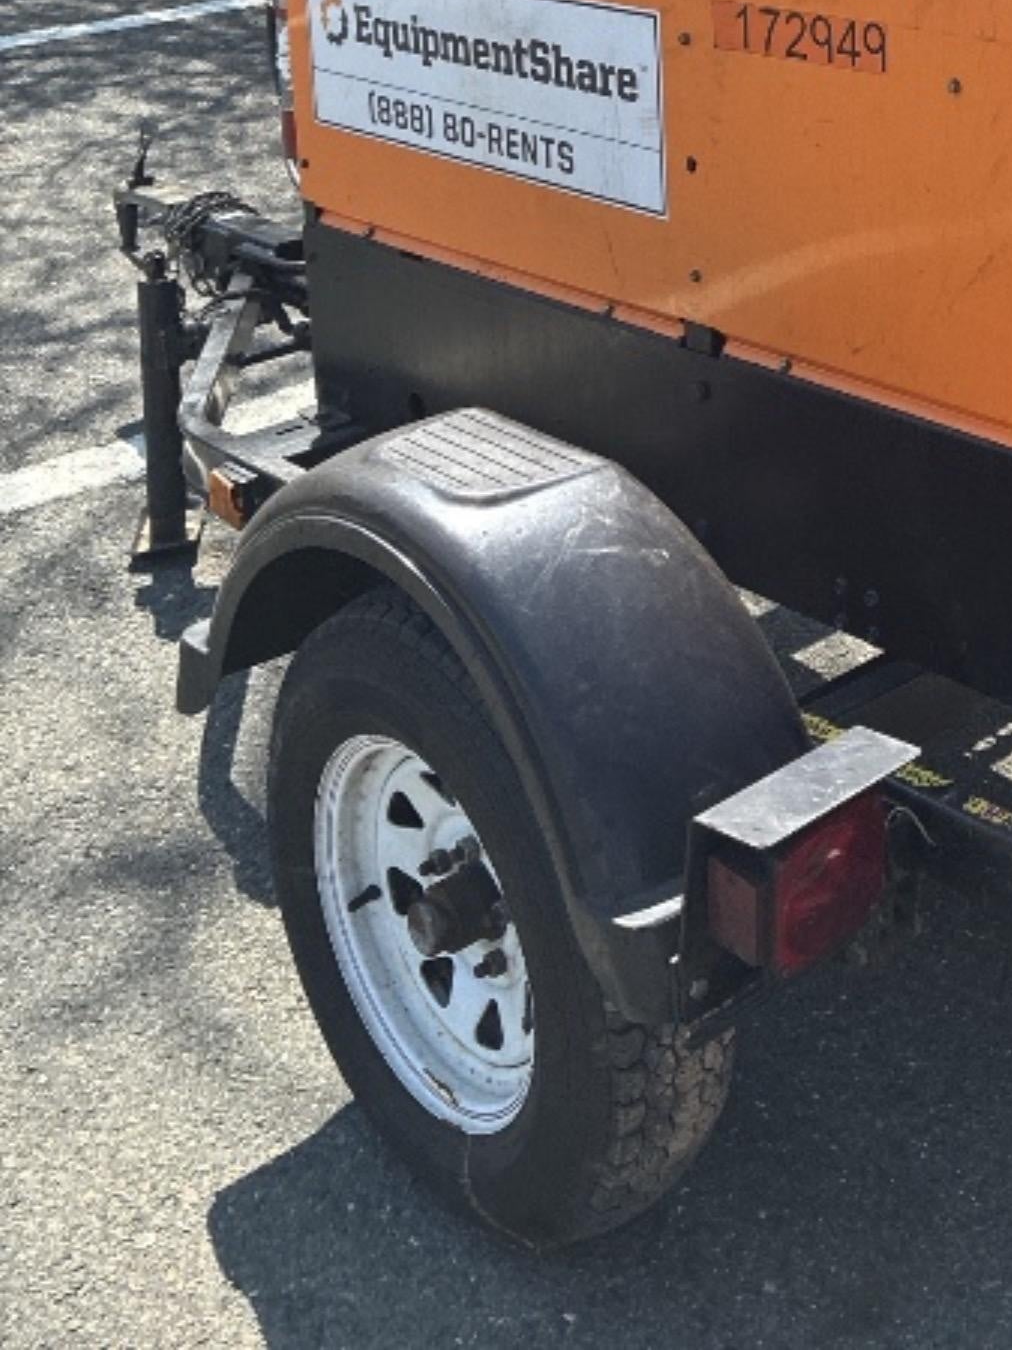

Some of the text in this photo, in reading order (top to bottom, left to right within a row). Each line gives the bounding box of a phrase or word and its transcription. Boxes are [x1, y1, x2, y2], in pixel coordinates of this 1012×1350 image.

[353, 4, 639, 103] EquipmentShare
[735, 3, 888, 74] 172949
[367, 90, 575, 175] (888) 80-RENTS
